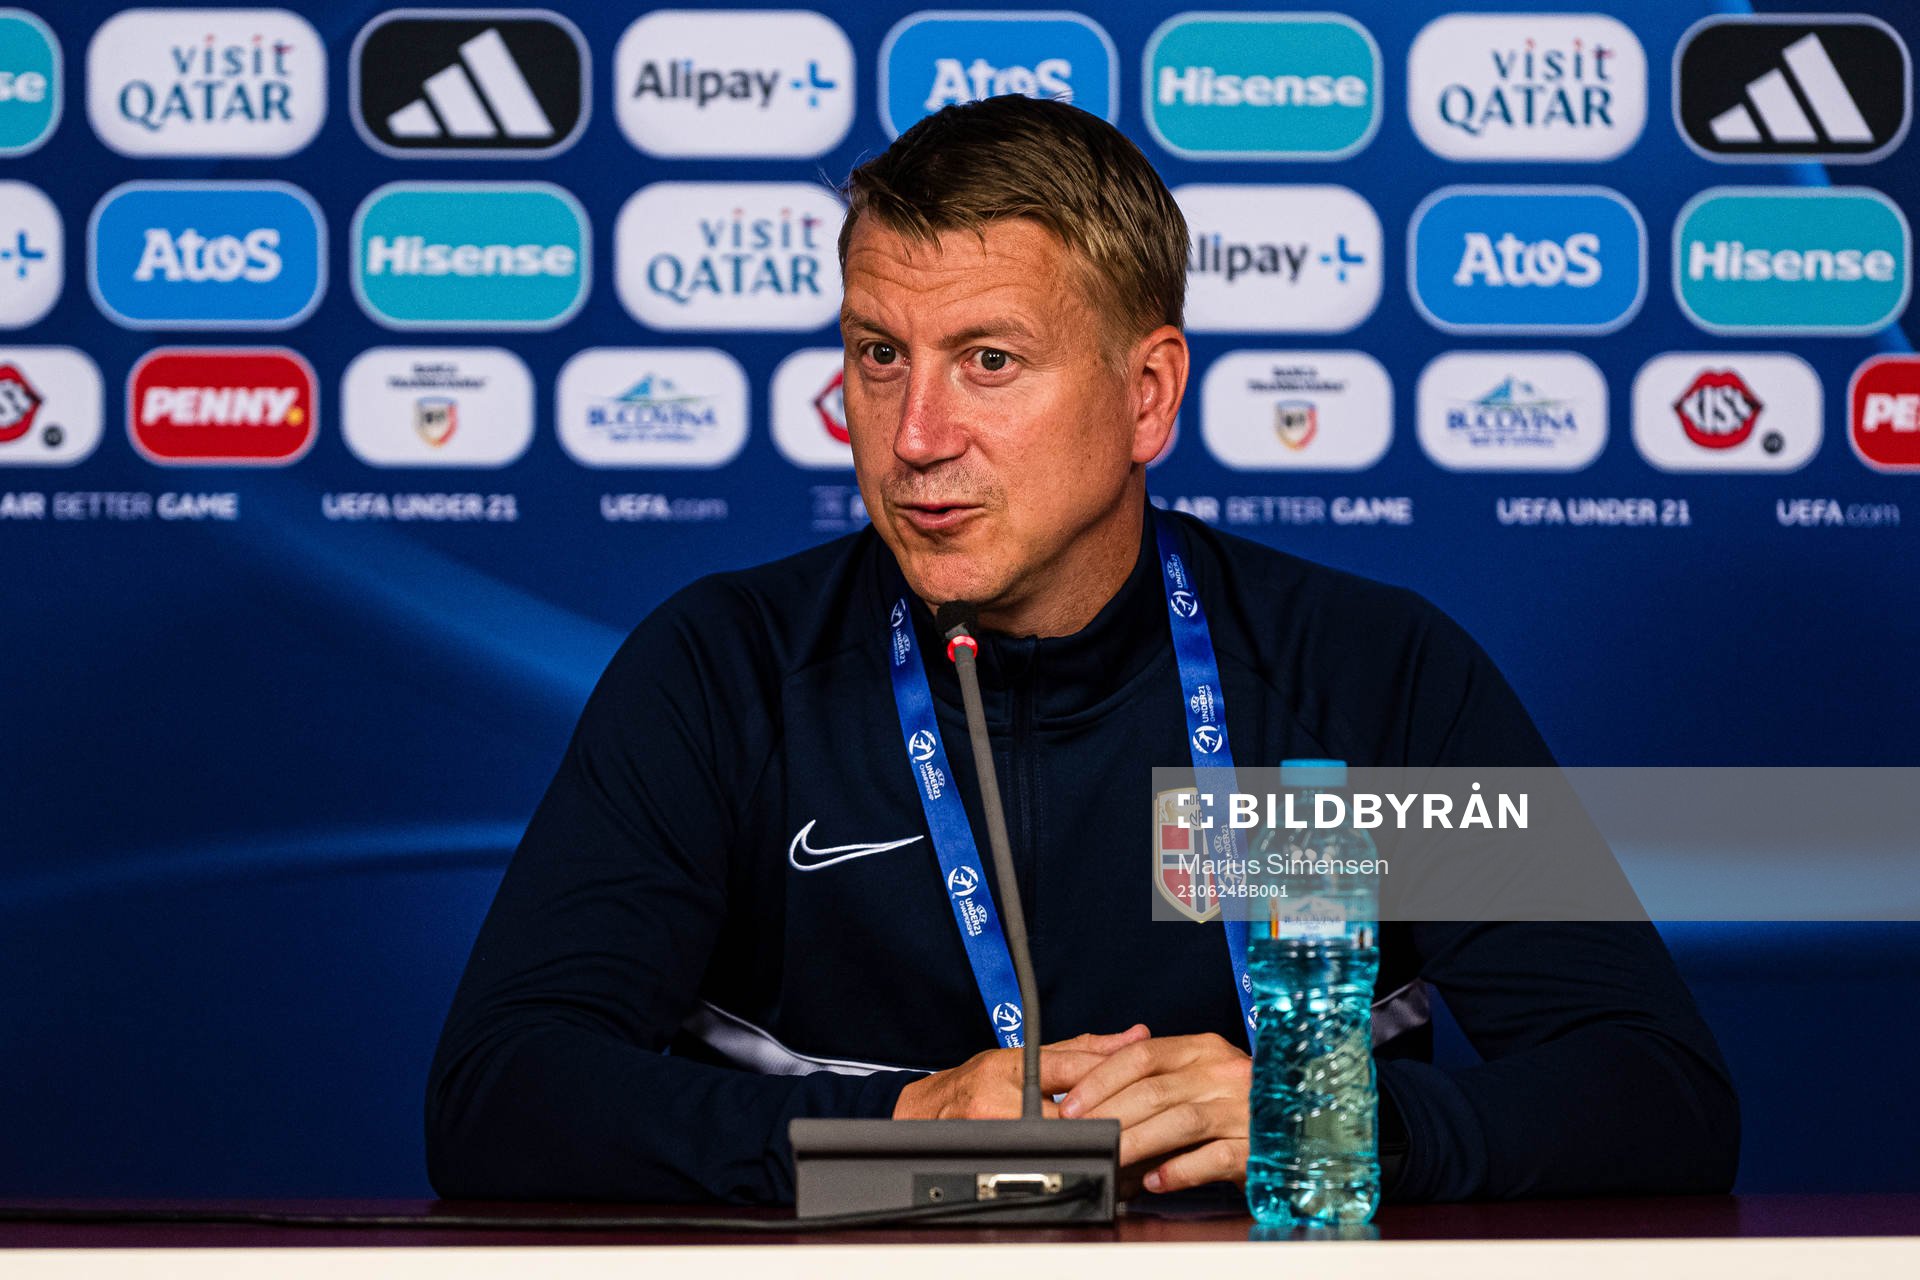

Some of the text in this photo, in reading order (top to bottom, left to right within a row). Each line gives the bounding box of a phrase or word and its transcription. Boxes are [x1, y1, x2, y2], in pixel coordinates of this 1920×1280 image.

[172, 36, 292, 76] visit
[1492, 38, 1614, 82] visit
[633, 60, 780, 108] Alipay
[1158, 66, 1368, 106] Hisense
[118, 81, 292, 131] QATAR
[1438, 85, 1615, 136] QATAR
[699, 209, 820, 250] visit
[366, 235, 577, 276] Hisense
[1186, 232, 1308, 284] lipay
[1688, 240, 1896, 283] Hisense
[646, 254, 822, 302] QATAR
[52, 492, 153, 519] BETTER
[157, 492, 239, 520] GAME
[321, 492, 517, 522] UEFA UNDER 21
[1226, 496, 1327, 525] BETTER
[1331, 496, 1413, 525] GAME
[1496, 497, 1690, 526] UEFA UNDER 21
[925, 761, 941, 799] UNDER21
[965, 897, 982, 935] UNDER21
